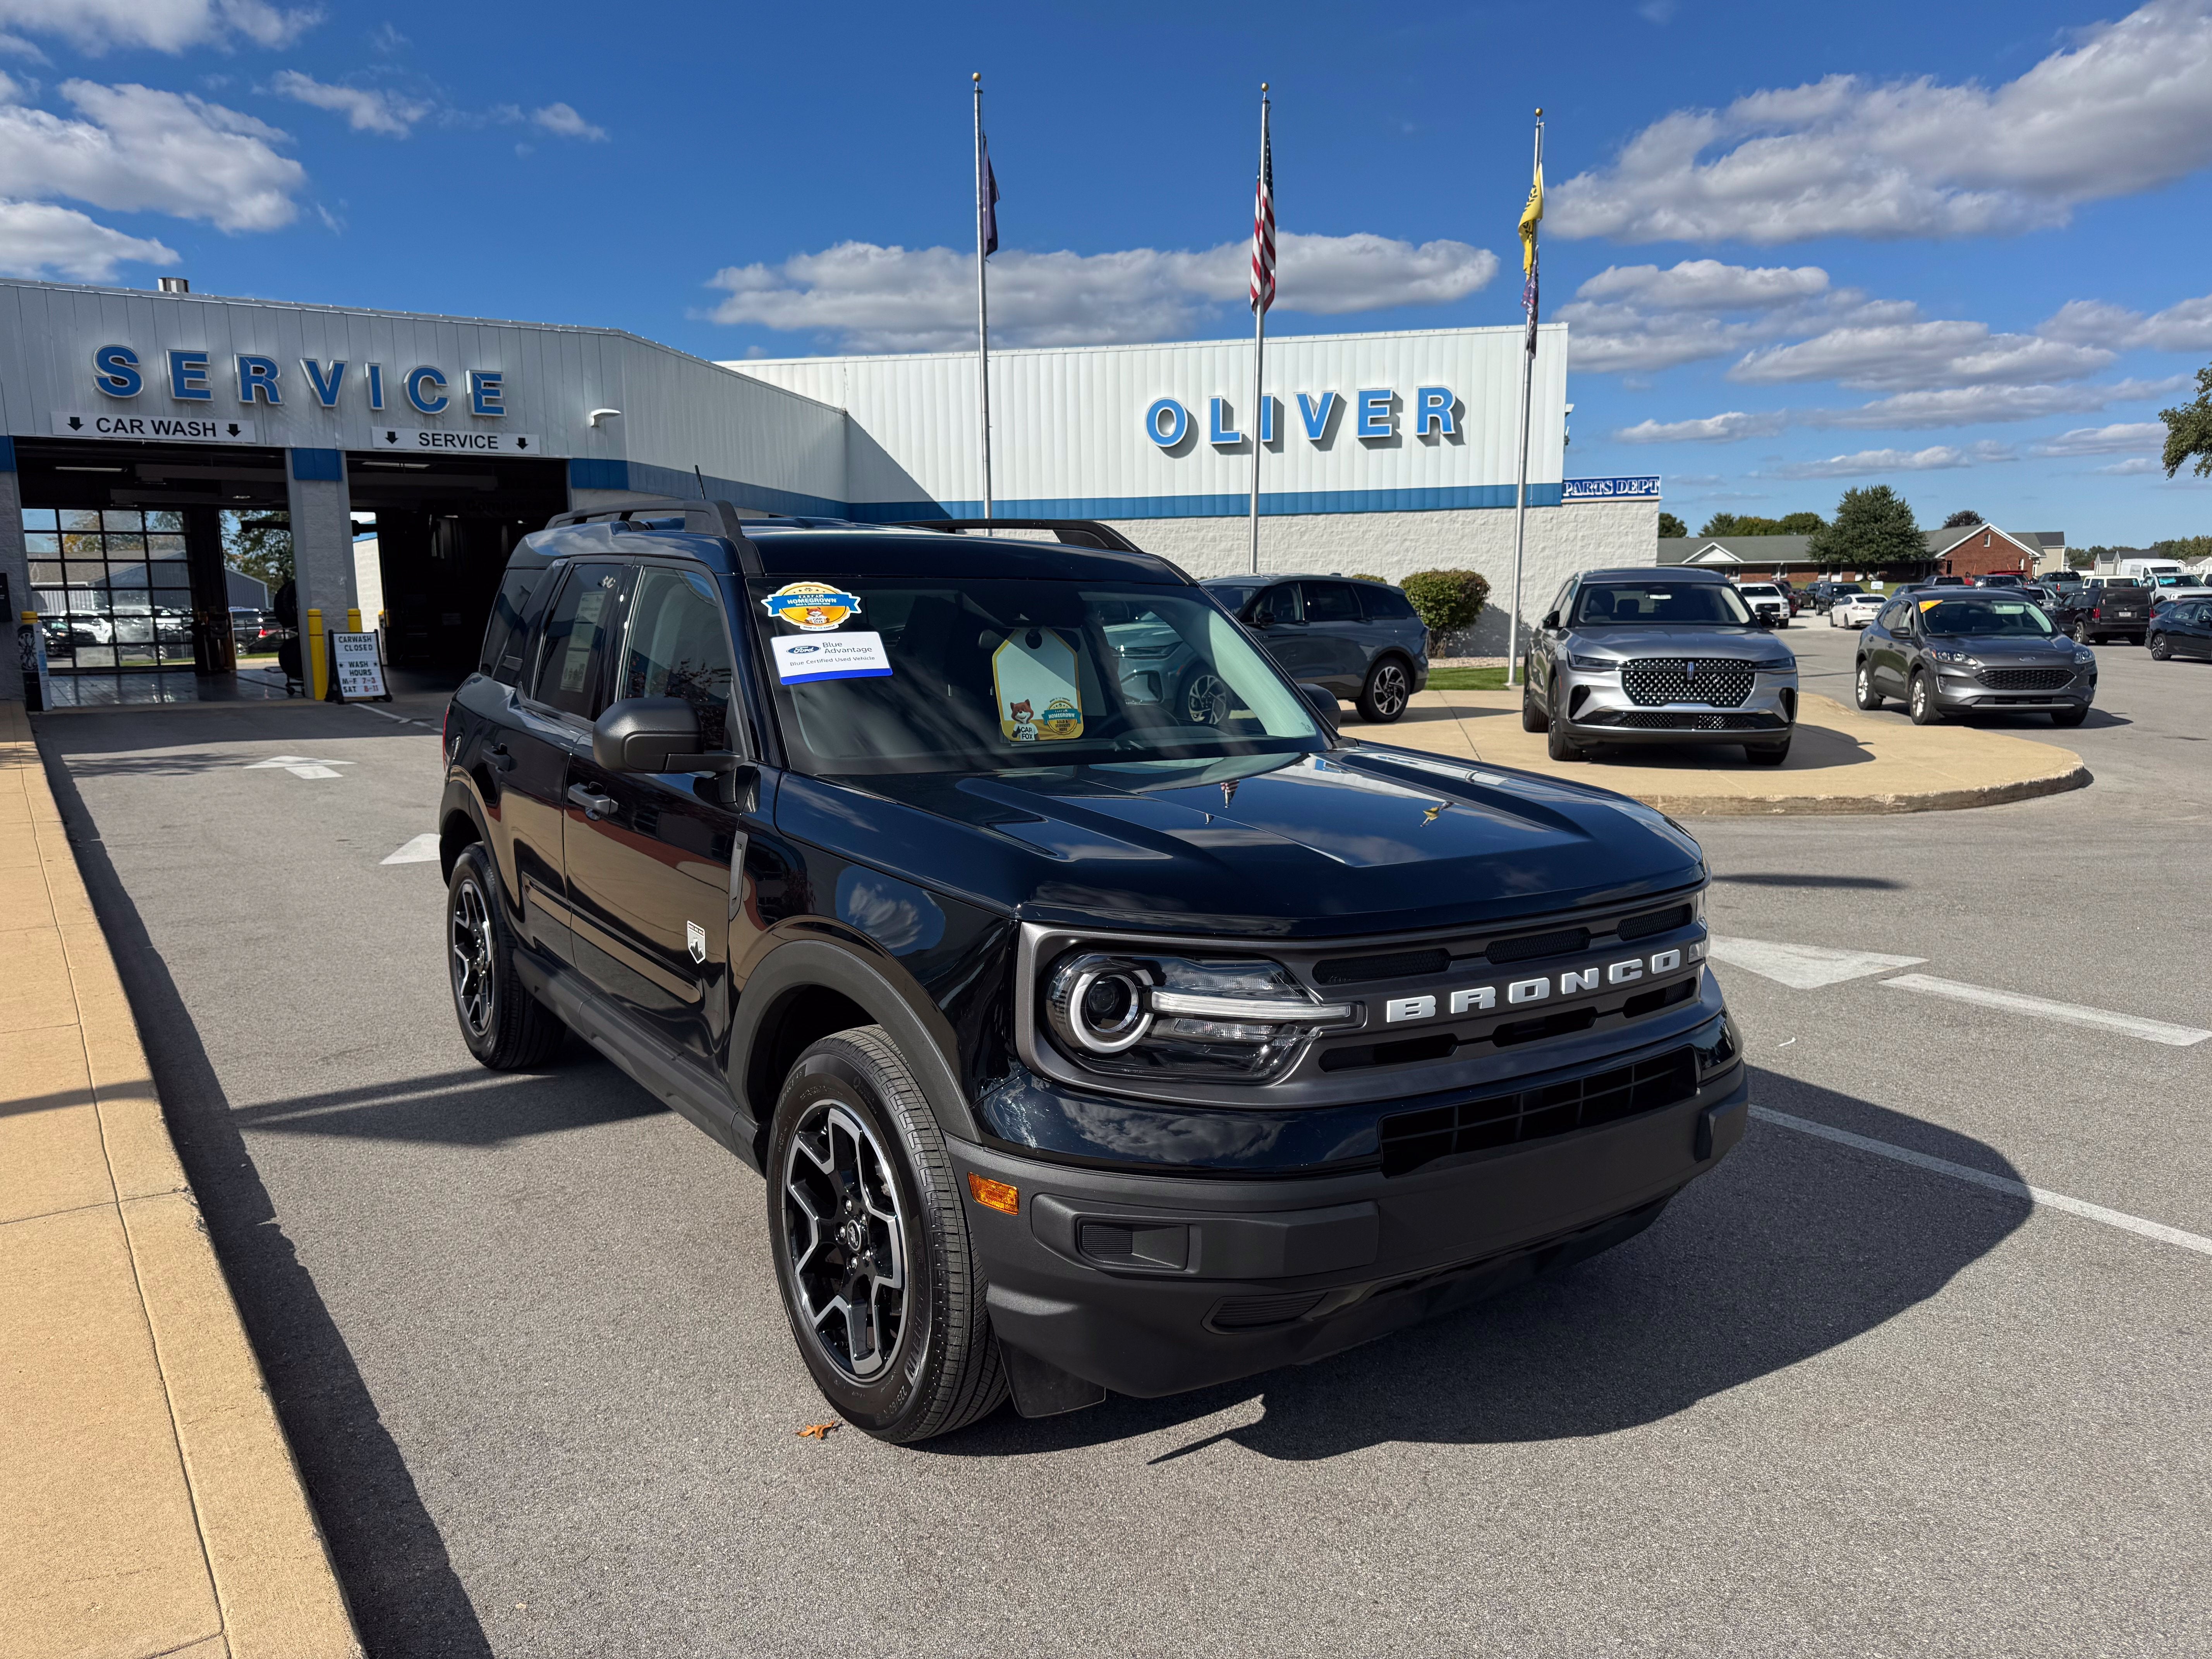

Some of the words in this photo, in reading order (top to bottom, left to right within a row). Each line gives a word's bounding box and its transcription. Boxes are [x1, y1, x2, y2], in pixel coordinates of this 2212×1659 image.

[93, 344, 507, 416] SERVICE
[96, 417, 146, 434] CAR
[150, 419, 216, 437] WASH
[1145, 385, 1456, 448] OLIVER
[419, 432, 499, 449] SERVICE
[1562, 480, 1613, 496] PARTS
[1616, 479, 1659, 494] DEPT
[1386, 949, 1680, 1023] BRONCO
[890, 1385, 907, 1414] 225/60
